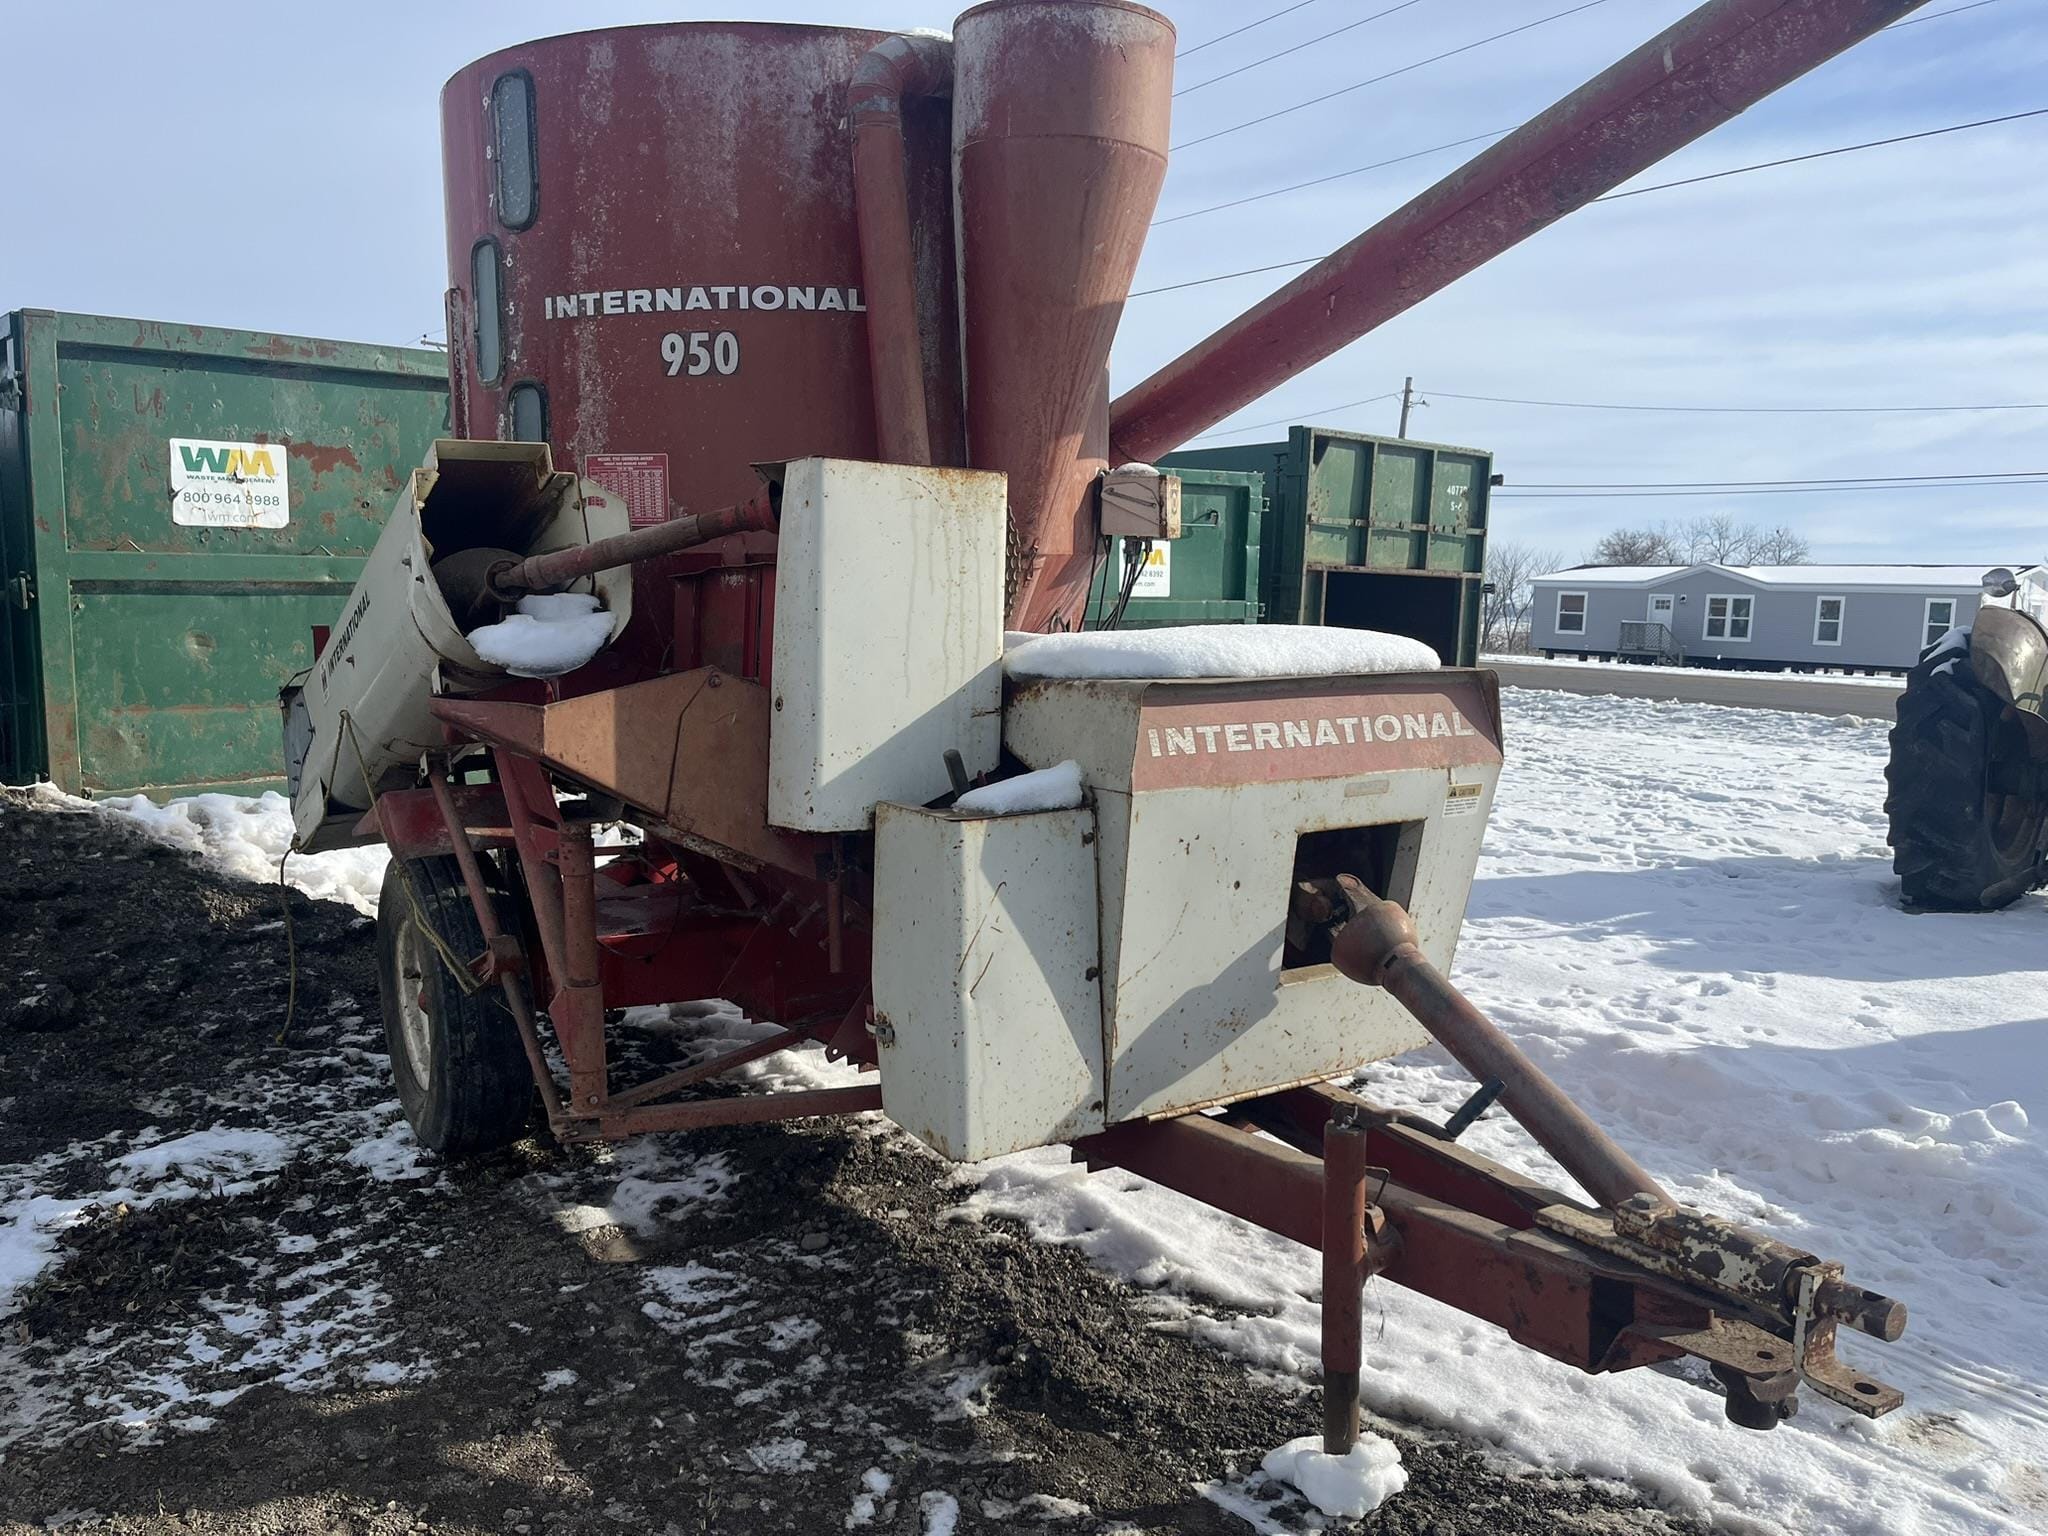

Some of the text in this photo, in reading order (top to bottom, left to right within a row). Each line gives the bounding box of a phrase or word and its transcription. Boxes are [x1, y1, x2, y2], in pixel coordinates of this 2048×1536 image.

[544, 285, 867, 320] INTERNATIONAL
[660, 331, 740, 377] 950
[178, 445, 277, 476] WM
[183, 491, 280, 506] 800 964 8988
[328, 590, 371, 678] INTERNATIONAL
[1147, 711, 1475, 757] INTERNATIONAL
